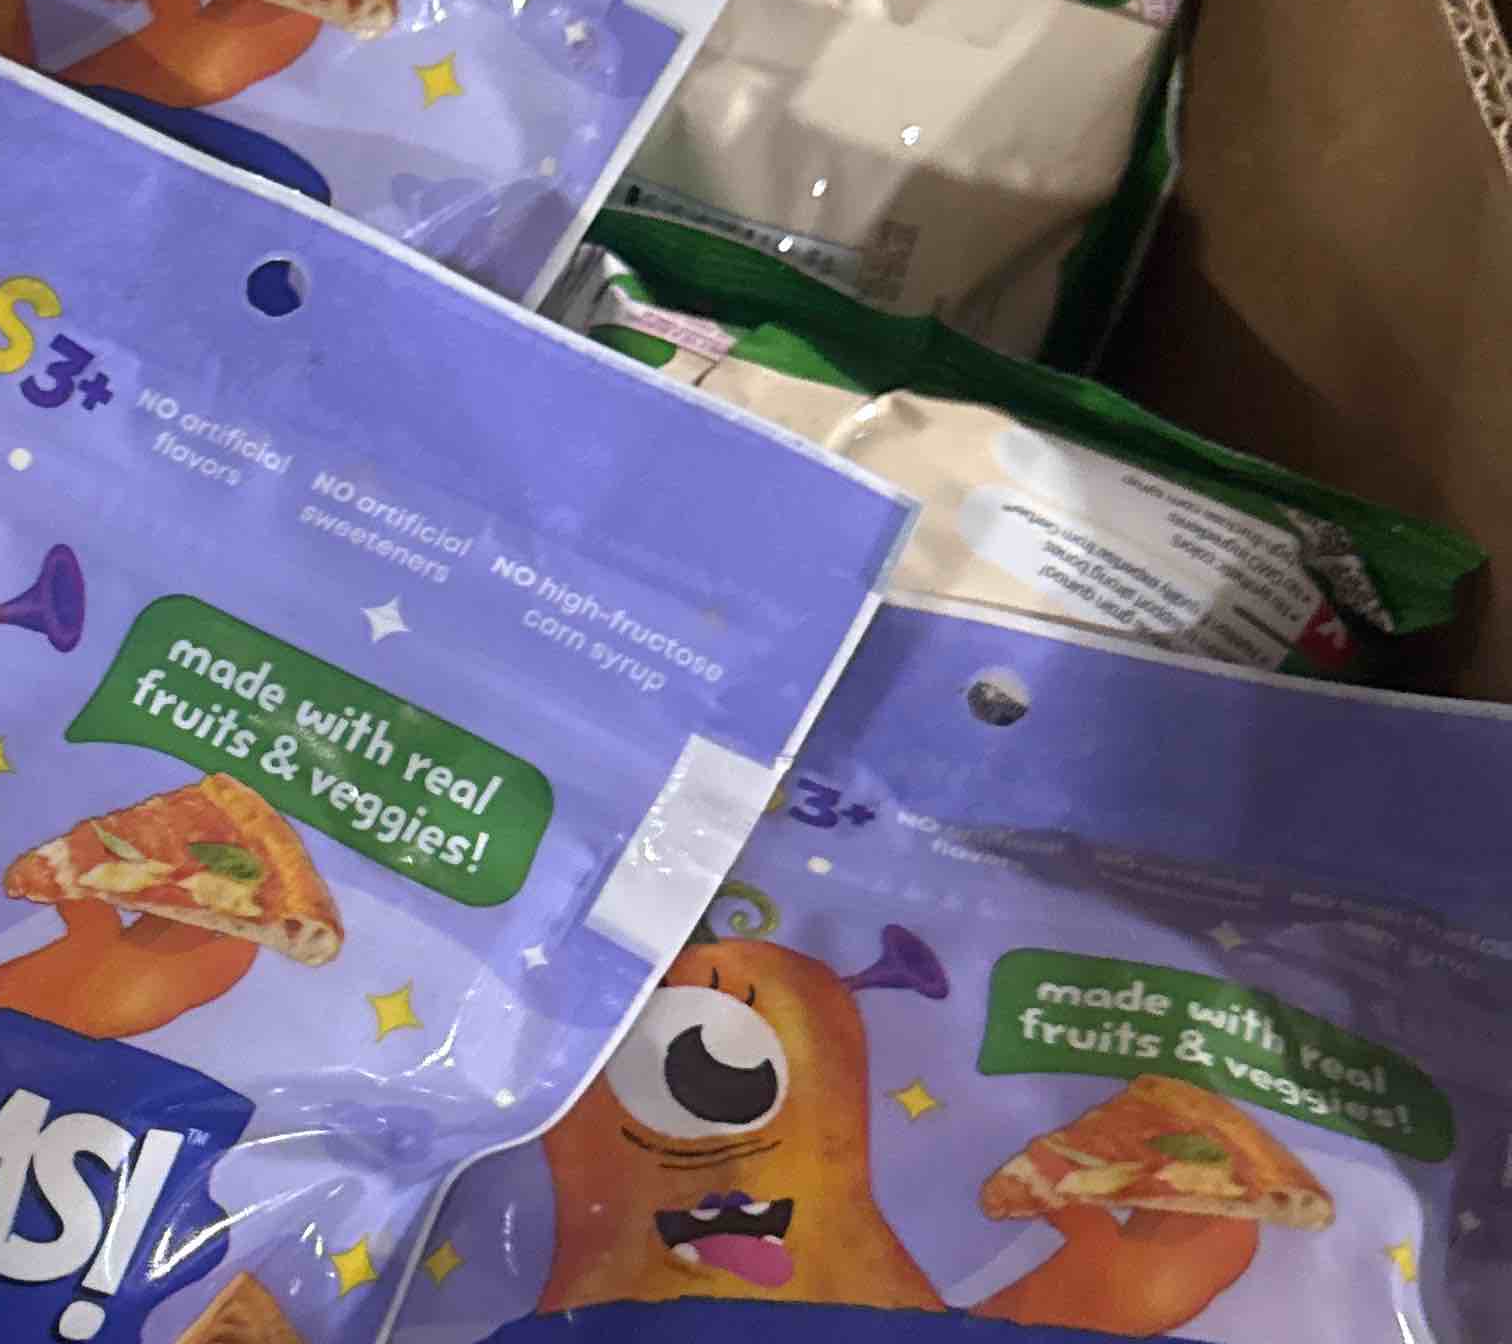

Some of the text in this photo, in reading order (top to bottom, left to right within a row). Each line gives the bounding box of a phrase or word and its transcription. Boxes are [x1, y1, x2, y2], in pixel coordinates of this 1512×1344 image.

[20, 332, 115, 415] 3+
[136, 388, 726, 684] NO artificial NO artificial NO high-fructose
[152, 430, 667, 695] flavors sweeteners corn syrup
[135, 668, 490, 874] fruits & veggies!
[169, 639, 504, 816] made with real
[789, 778, 877, 830] 3+
[1018, 1006, 1415, 1136] fruits & veggies!
[1036, 978, 1387, 1095] made with real
